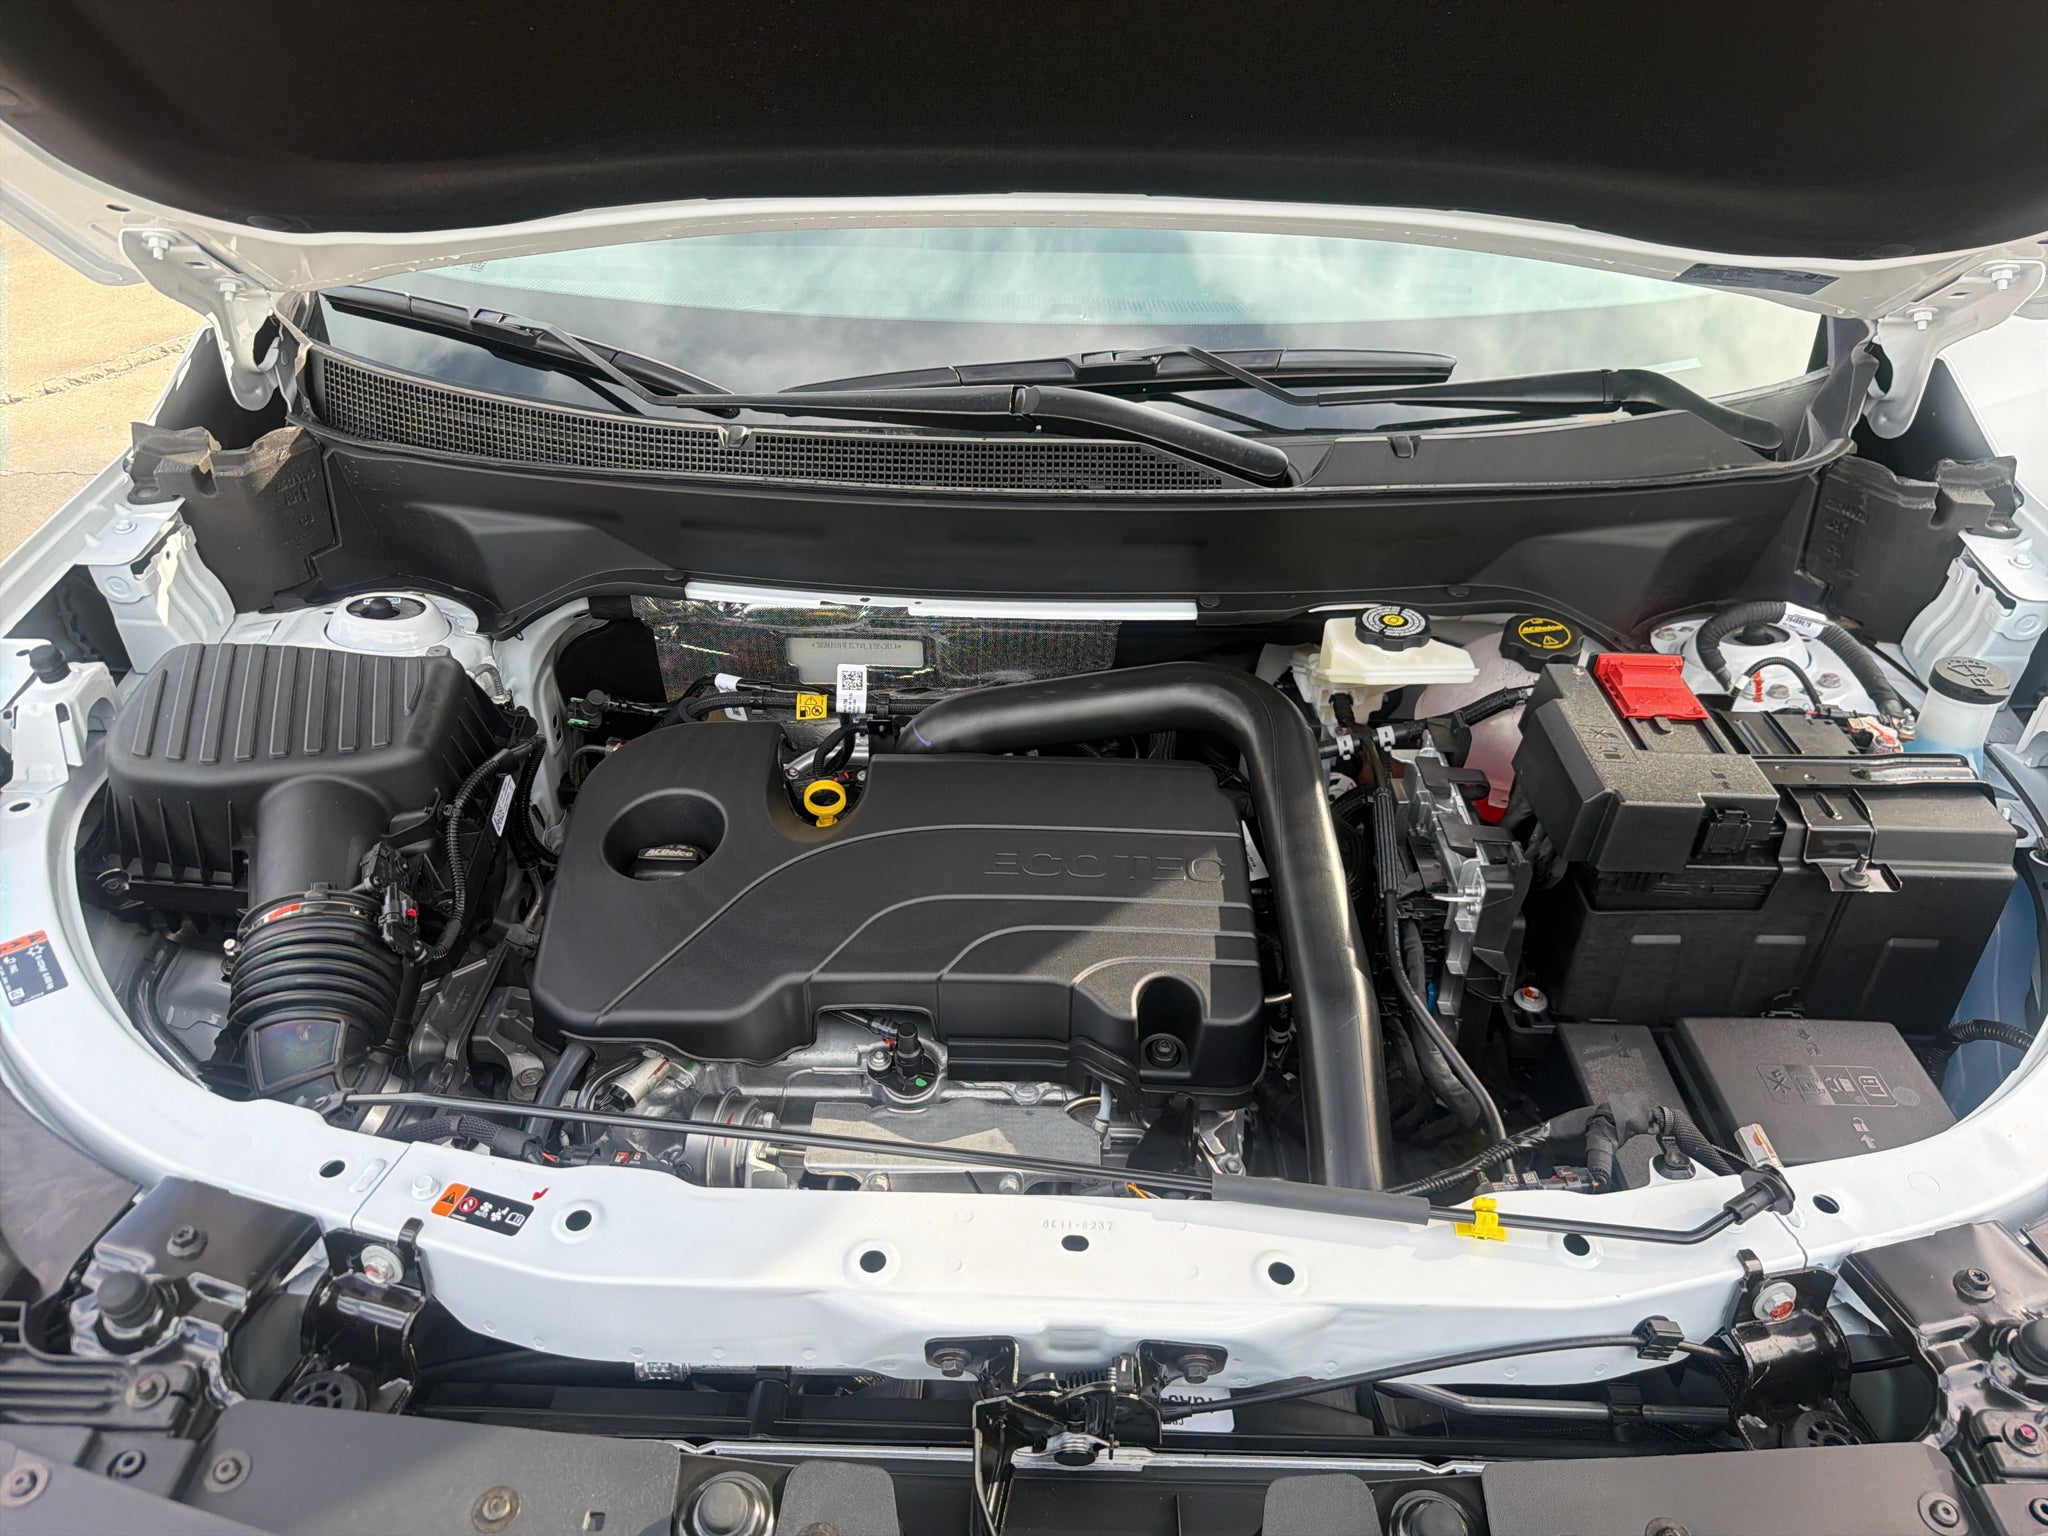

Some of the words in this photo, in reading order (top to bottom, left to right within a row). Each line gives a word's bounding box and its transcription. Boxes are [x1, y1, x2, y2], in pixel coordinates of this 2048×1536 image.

[644, 848, 694, 857] ACDelco
[984, 851, 1226, 882] ECOTEC
[474, 1210, 488, 1218] AUTO
